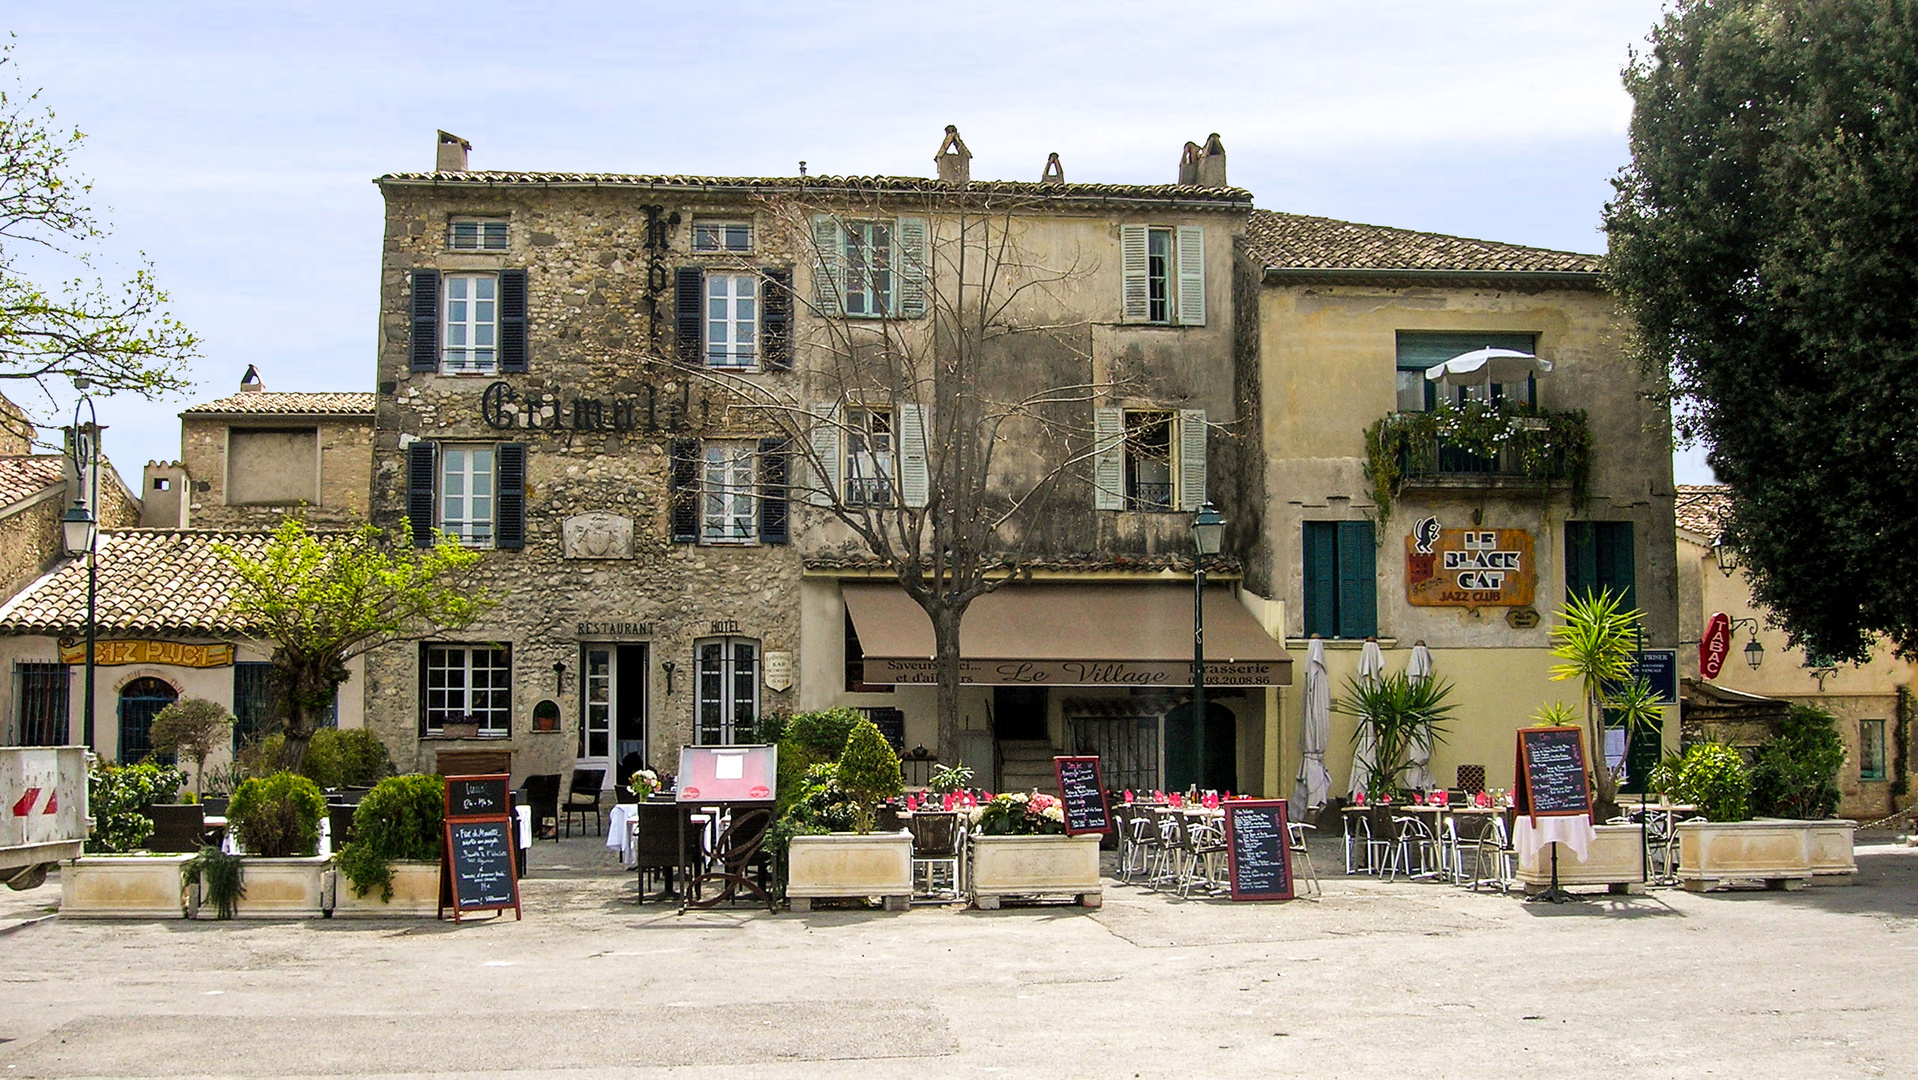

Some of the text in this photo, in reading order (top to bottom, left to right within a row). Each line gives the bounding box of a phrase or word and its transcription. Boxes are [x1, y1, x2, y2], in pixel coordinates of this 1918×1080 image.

[1465, 532, 1496, 550] LE
[1444, 550, 1521, 572] BLACK
[1457, 570, 1505, 590] CAT
[1440, 591, 1500, 602] JAZZ CLUB
[577, 622, 655, 635] RESTAURANT
[1706, 620, 1728, 674] TABAC
[887, 660, 938, 671] Saveurs
[896, 672, 974, 683] et d'ailrs
[996, 662, 1170, 685] Le Village
[1188, 676, 1271, 686] 0.93.20.08.86
